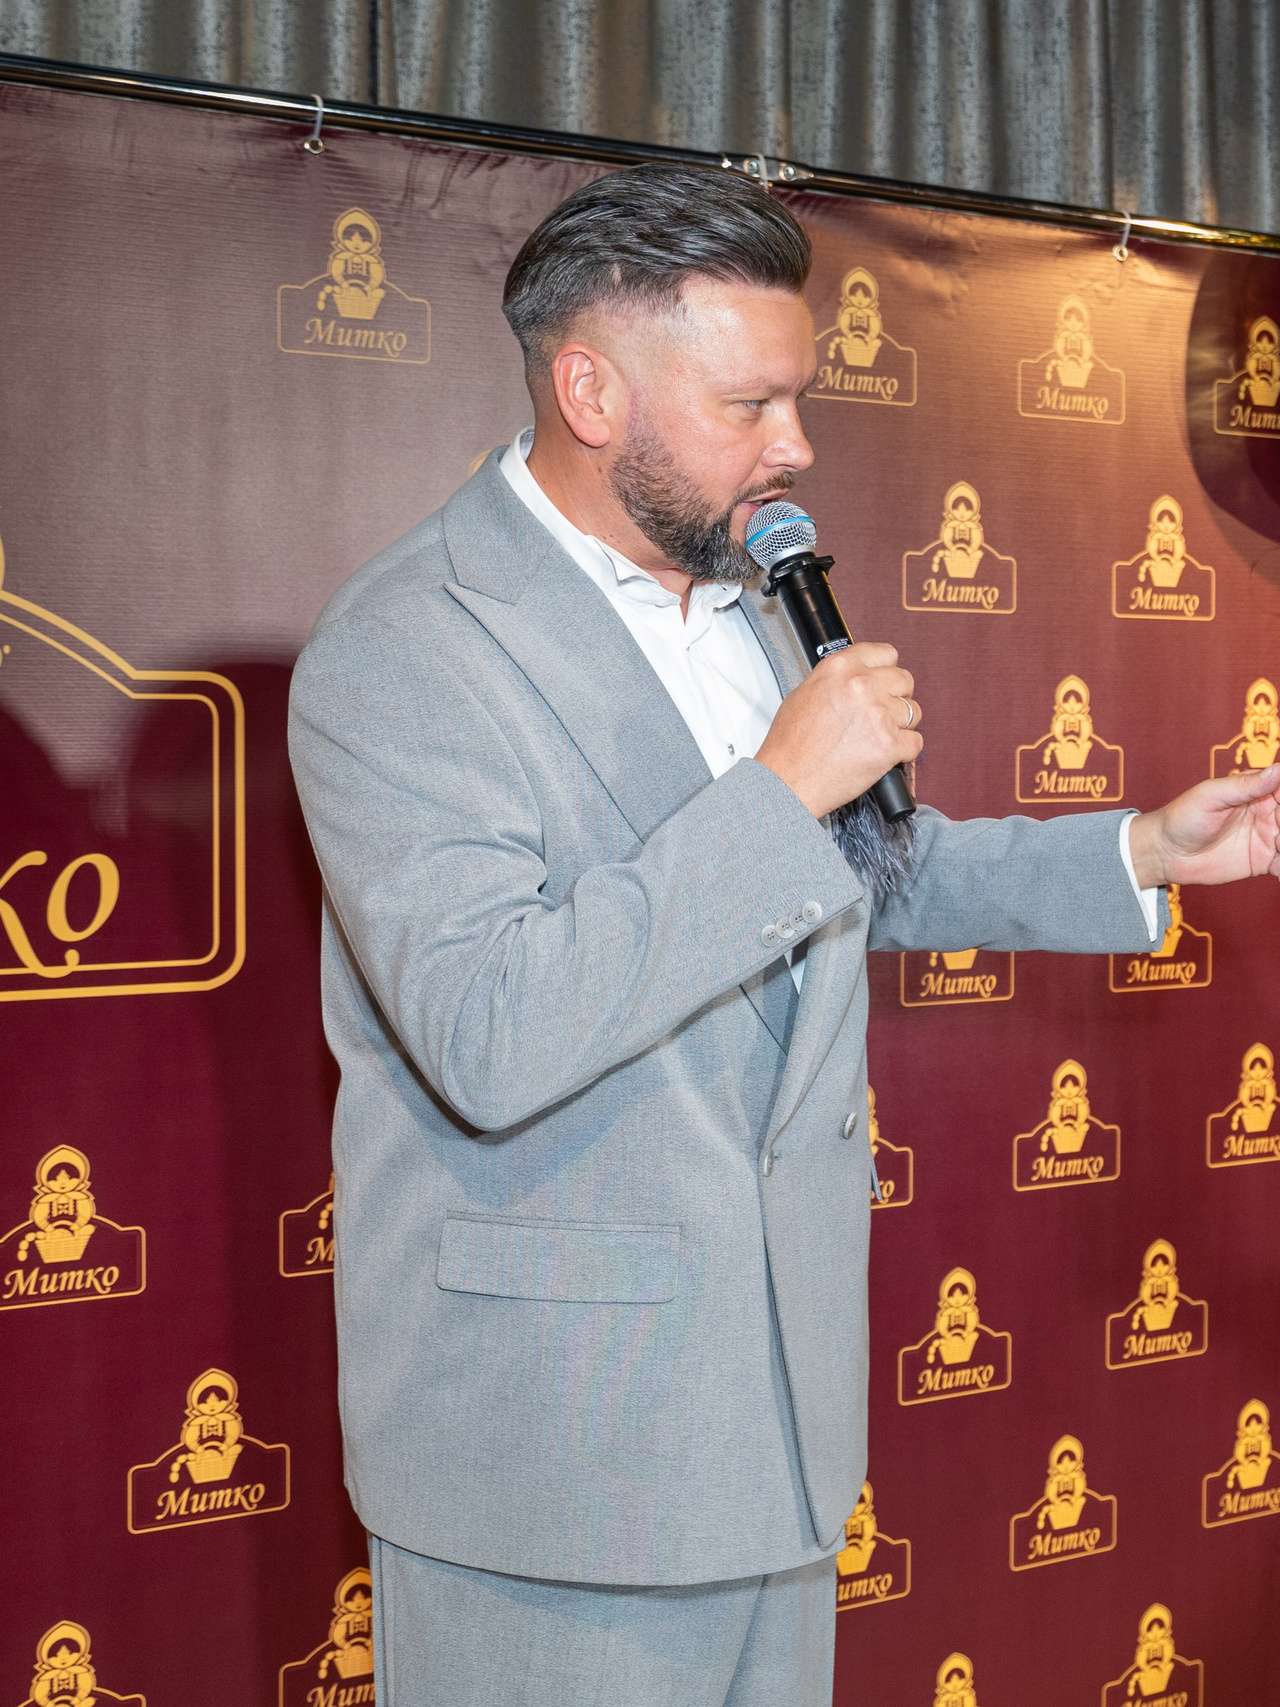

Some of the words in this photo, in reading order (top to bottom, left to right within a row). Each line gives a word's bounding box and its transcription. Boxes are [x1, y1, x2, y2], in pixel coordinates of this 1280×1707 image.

[305, 318, 407, 358] Митко
[818, 365, 899, 400] Митко
[1037, 385, 1108, 420] Митко
[923, 578, 999, 610] Митко
[1130, 586, 1200, 617] Митко
[1035, 769, 1106, 798] Митко
[921, 972, 996, 998] Митко
[1127, 959, 1196, 985] Митко
[1032, 1156, 1104, 1182] Митко
[3, 1265, 120, 1299] Митко
[1122, 1331, 1192, 1359] Митко
[917, 1365, 994, 1394] Митко
[155, 1482, 265, 1520] Митко
[1028, 1527, 1100, 1559] Митко
[836, 1573, 893, 1602] итко
[306, 1682, 375, 1707] Мит
